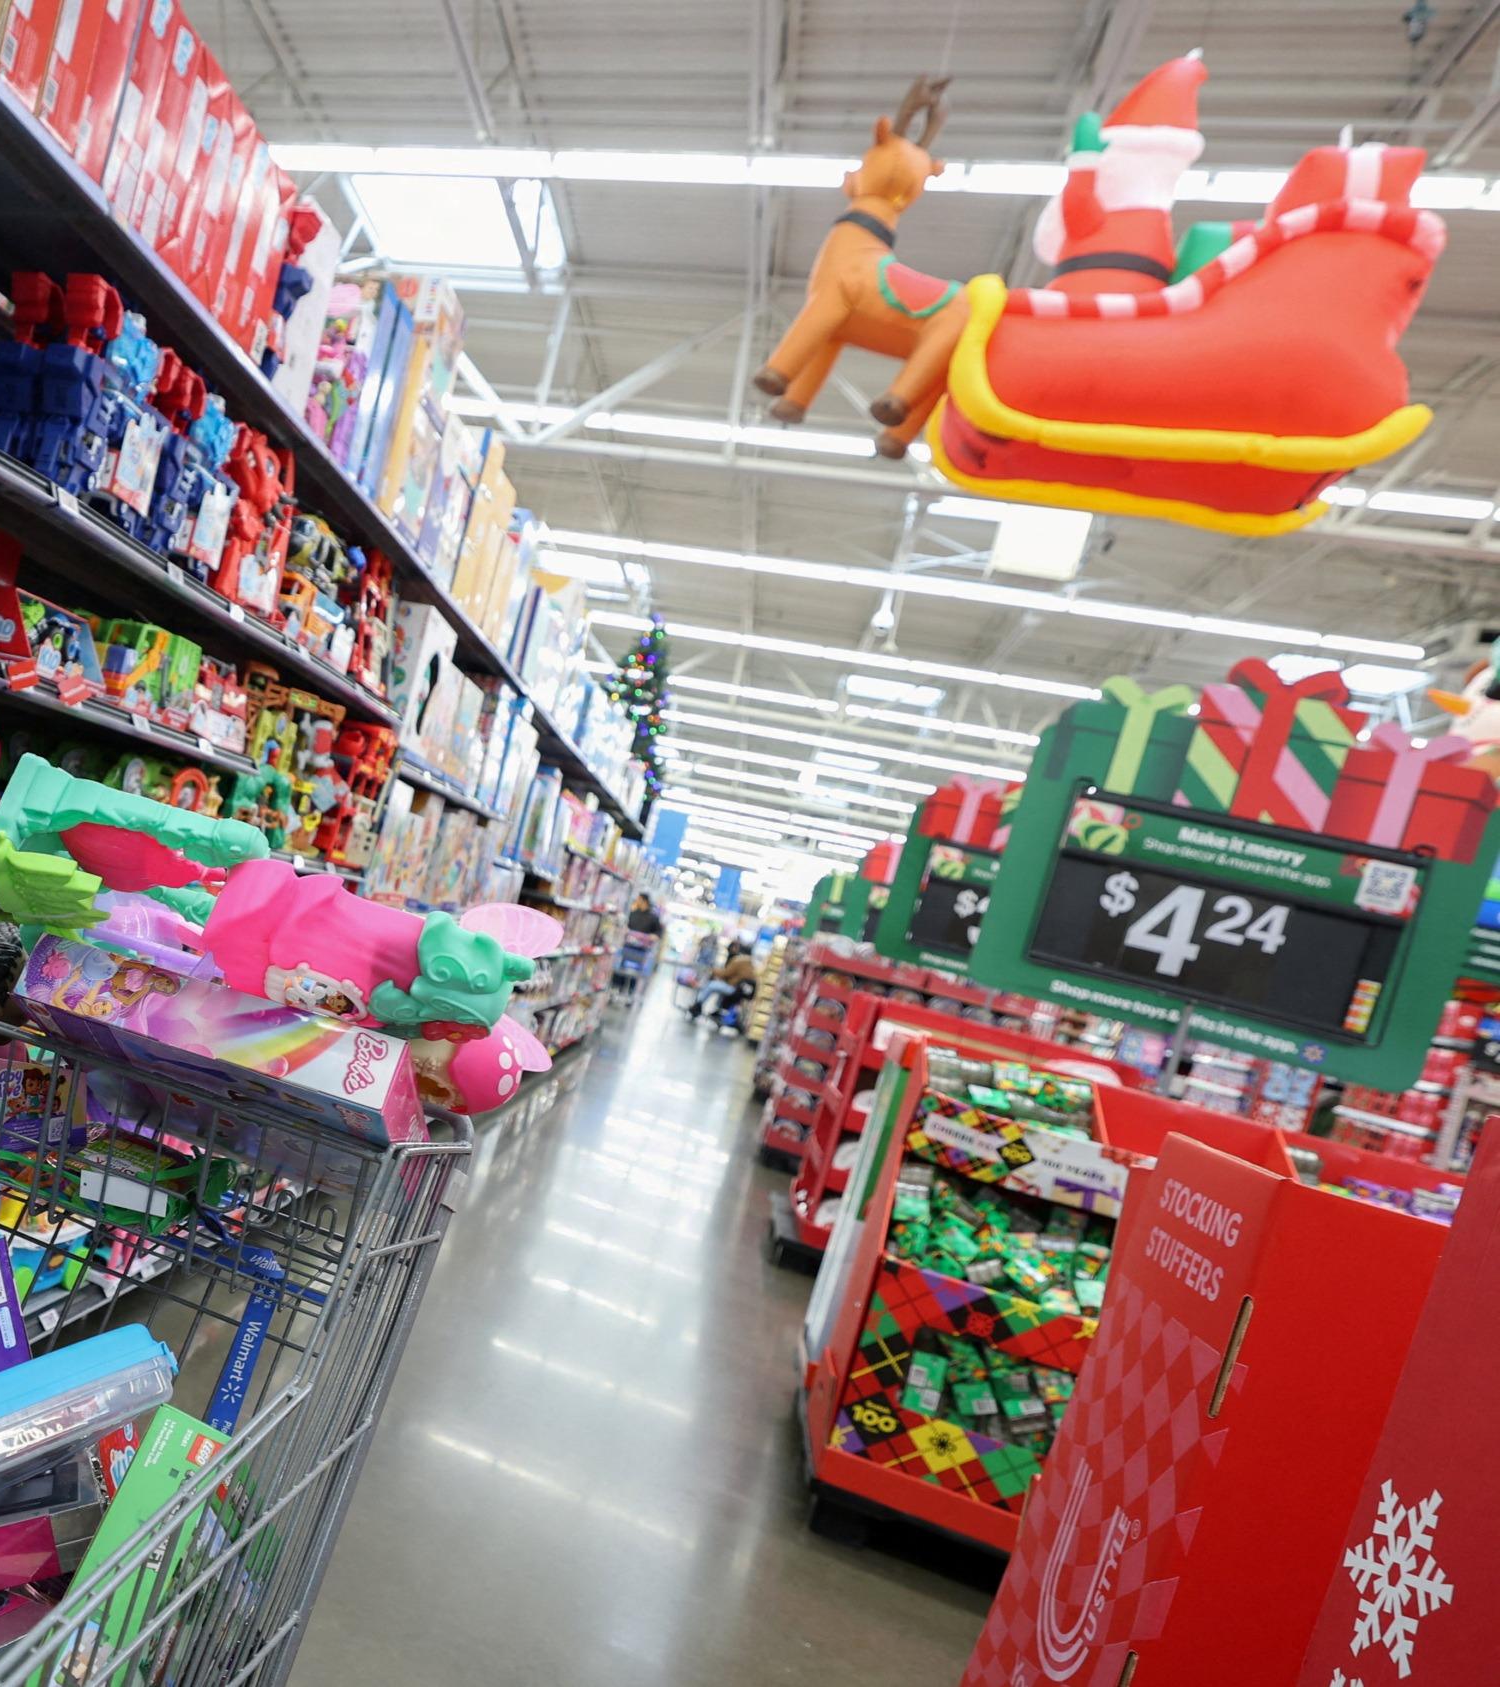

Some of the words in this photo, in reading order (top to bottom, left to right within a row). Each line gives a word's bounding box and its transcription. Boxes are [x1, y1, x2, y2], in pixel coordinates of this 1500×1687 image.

[40, 651, 61, 670] KID
[1143, 837, 1176, 856] Shop
[1177, 826, 1229, 850] Make
[1246, 843, 1307, 867] merry
[1050, 979, 1089, 1002] Shop
[1089, 991, 1132, 1011] more
[1133, 1000, 1167, 1020] toys
[343, 1032, 389, 1095] Barbie
[1159, 1178, 1243, 1247] STOCKING
[1145, 1226, 1224, 1301] STUFFERS
[229, 1321, 262, 1382] Walmart
[852, 1404, 898, 1433] 100
[195, 1439, 215, 1466] LEGO
